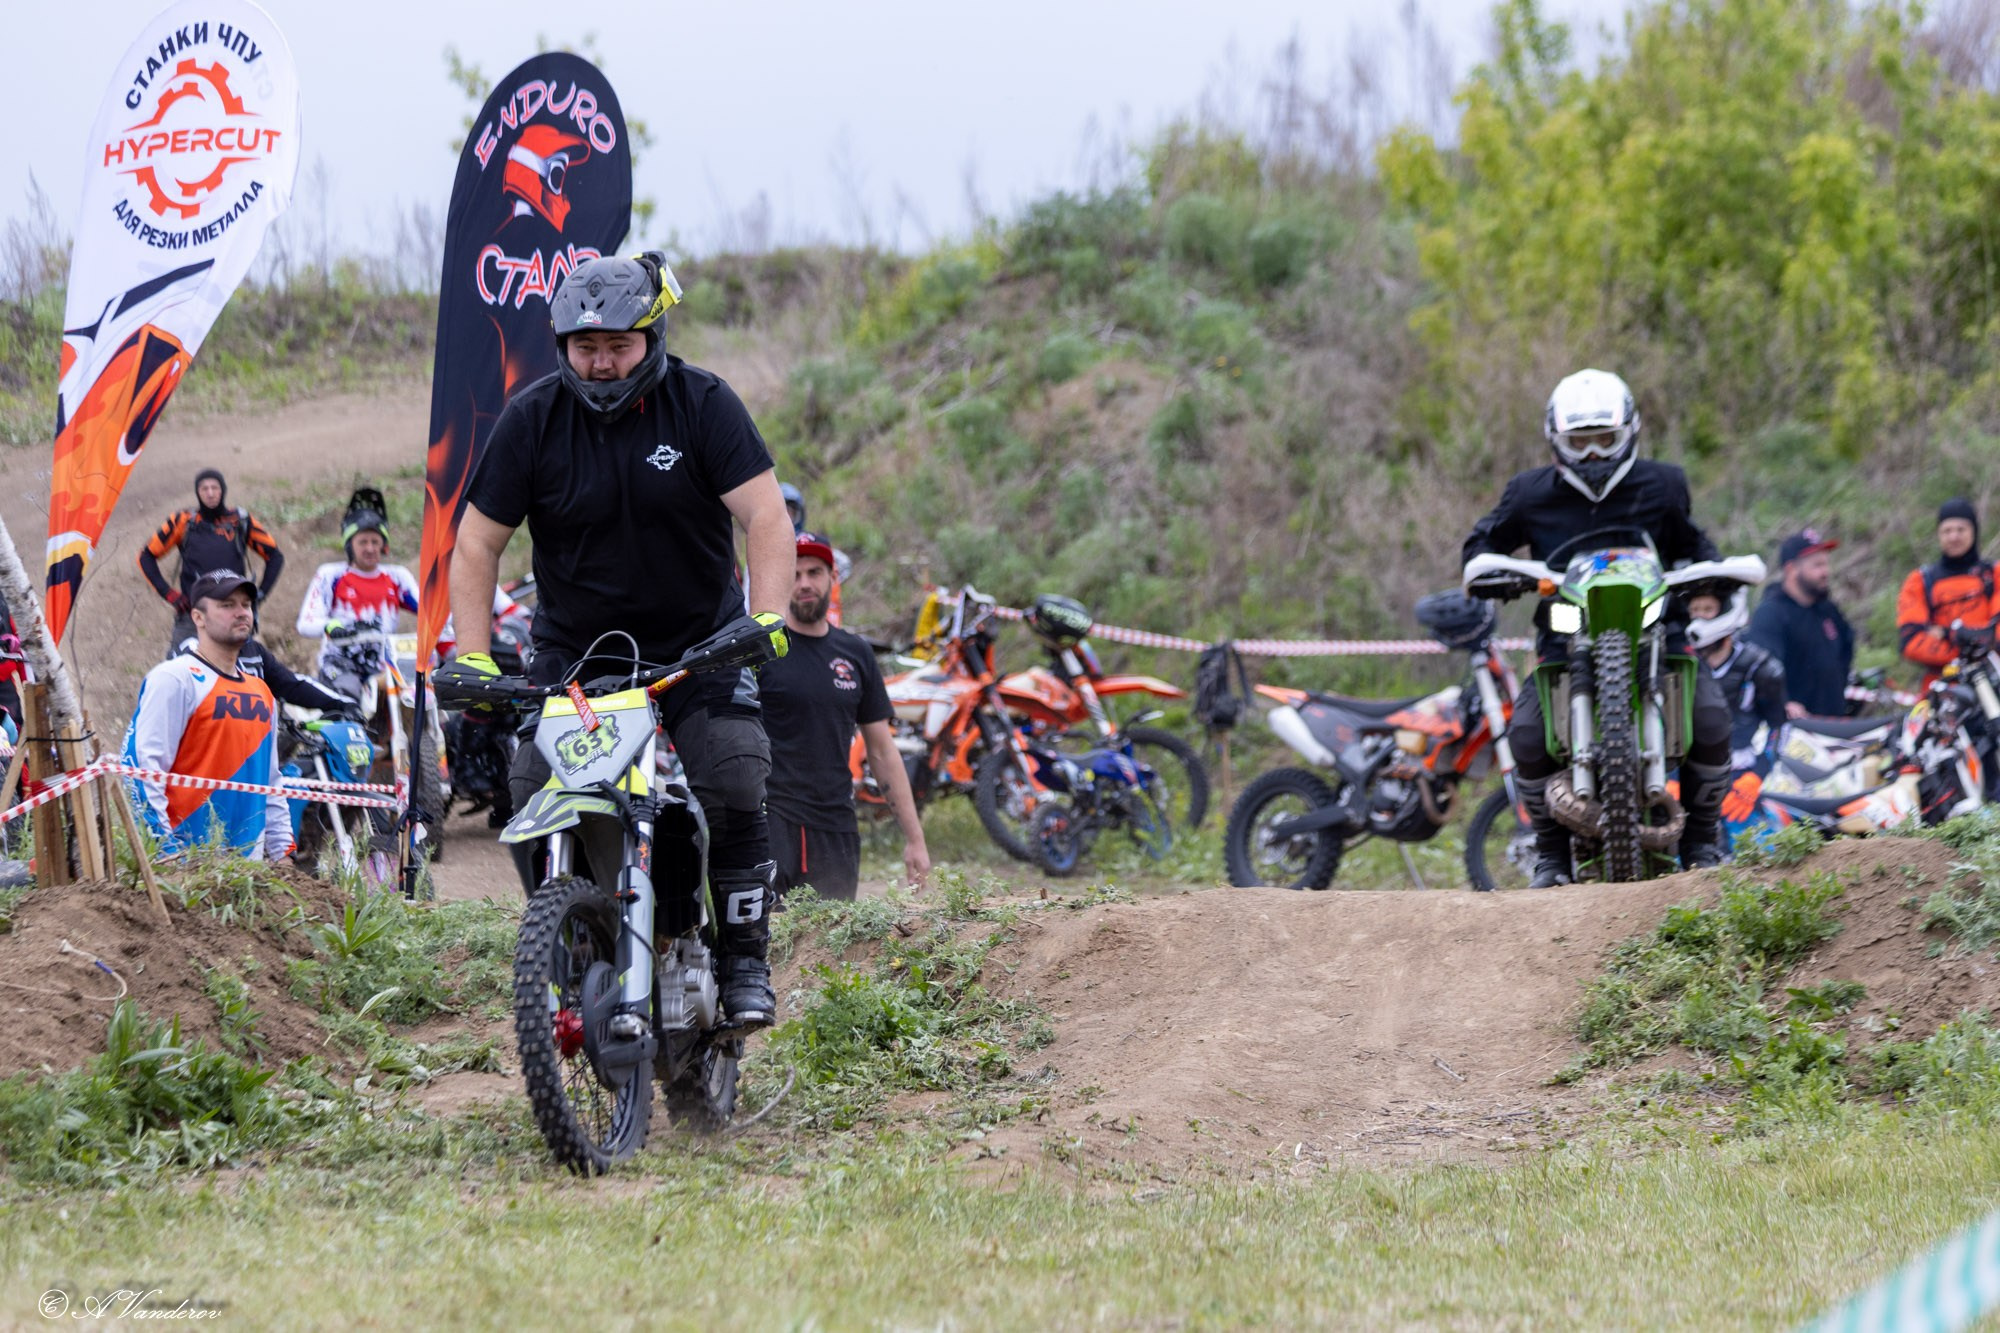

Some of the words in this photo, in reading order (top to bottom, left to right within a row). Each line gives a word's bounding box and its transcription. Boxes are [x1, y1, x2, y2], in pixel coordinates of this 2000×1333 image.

[125, 21, 209, 110] СТАНКИ
[218, 22, 263, 64] ЧПУ
[474, 79, 617, 172] ENDURO
[103, 127, 283, 168] HYPERCUT
[112, 198, 142, 235] ДЛЯ
[138, 223, 189, 250] РЕЗКИ
[192, 180, 264, 246] МЕТАЛЛА
[212, 690, 271, 723] KTM
[573, 731, 603, 757] 63
[726, 887, 764, 924] G
